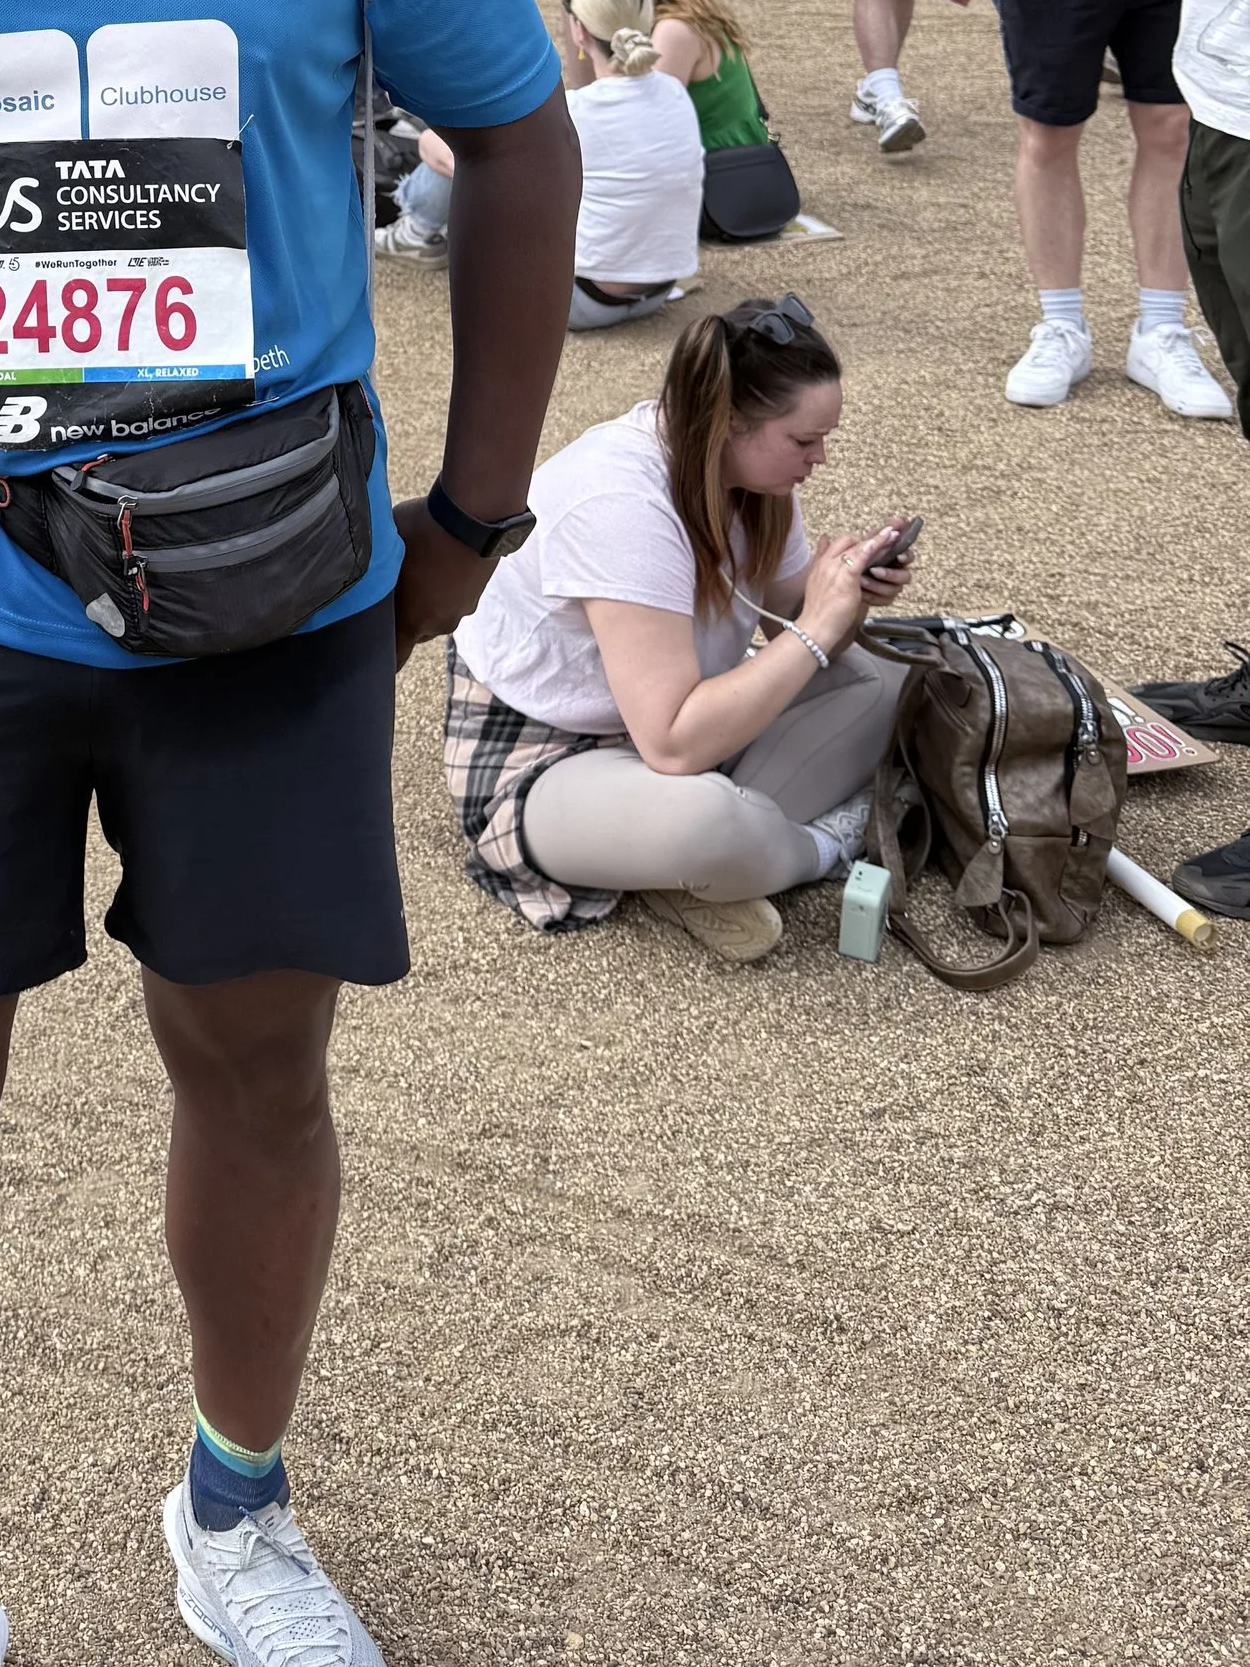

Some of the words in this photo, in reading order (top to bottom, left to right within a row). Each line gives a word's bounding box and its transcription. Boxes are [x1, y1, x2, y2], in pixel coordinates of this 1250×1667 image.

[100, 86, 227, 106] Clubhouse
[55, 159, 126, 180] TATA
[56, 183, 221, 205] CONSULTANCY
[57, 209, 162, 231] SERVICES
[35, 258, 117, 271] #WeRunTogether
[137, 368, 152, 378] XL,
[155, 367, 198, 377] RELAXED
[51, 424, 104, 442] new
[111, 407, 221, 437] balance
